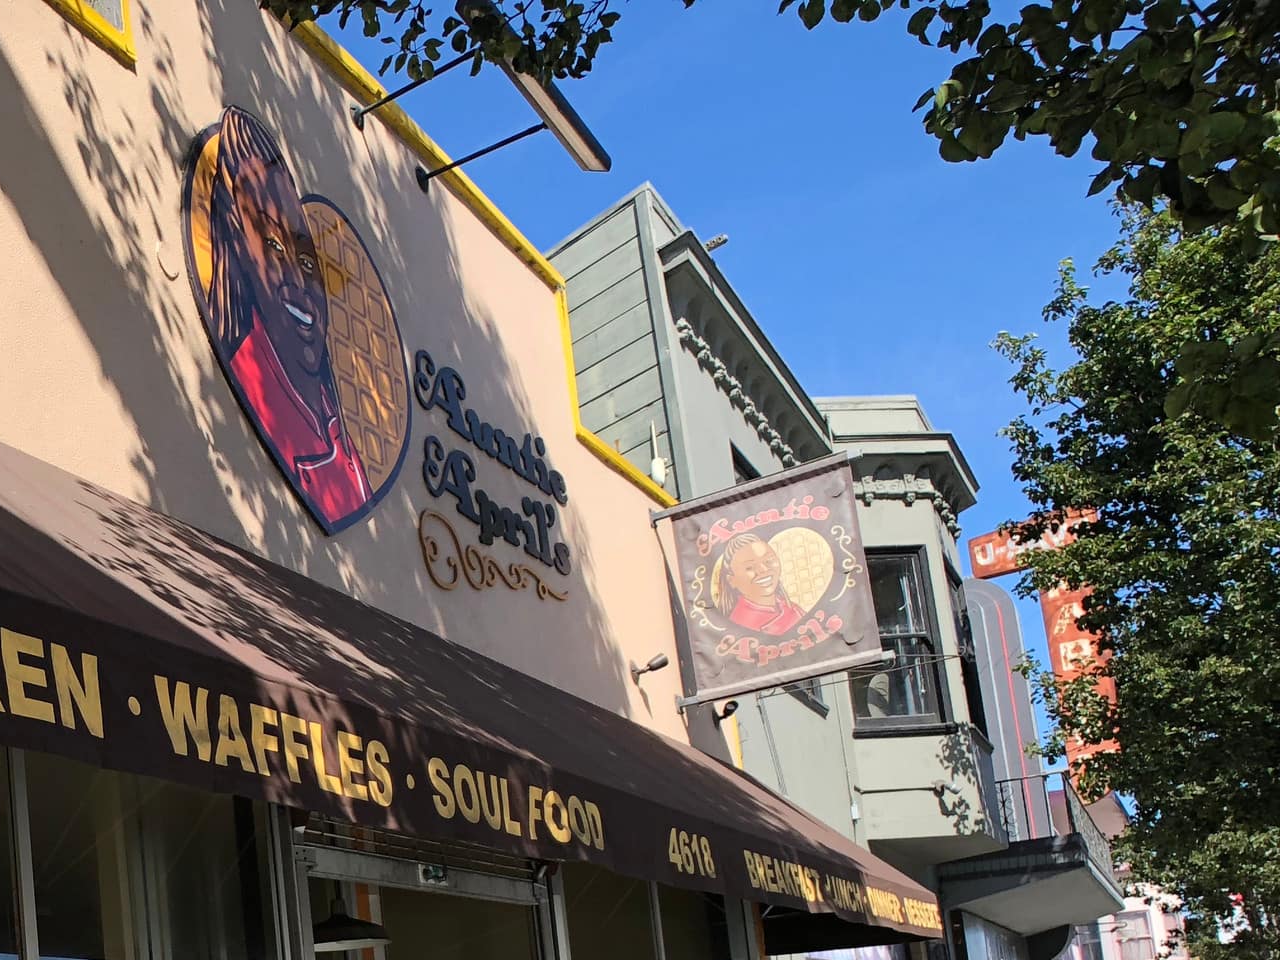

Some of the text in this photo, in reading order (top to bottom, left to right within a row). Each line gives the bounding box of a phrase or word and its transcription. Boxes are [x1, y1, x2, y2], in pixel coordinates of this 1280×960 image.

[414, 350, 568, 505] Auntie
[423, 435, 570, 575] April's
[696, 495, 830, 556] Auntie
[715, 610, 844, 666] April's
[154, 674, 393, 808] WAFFLES
[427, 757, 523, 837] SOUL
[529, 784, 605, 851] FOOD
[668, 827, 717, 879] 4618
[743, 849, 825, 903] BREAKFAST
